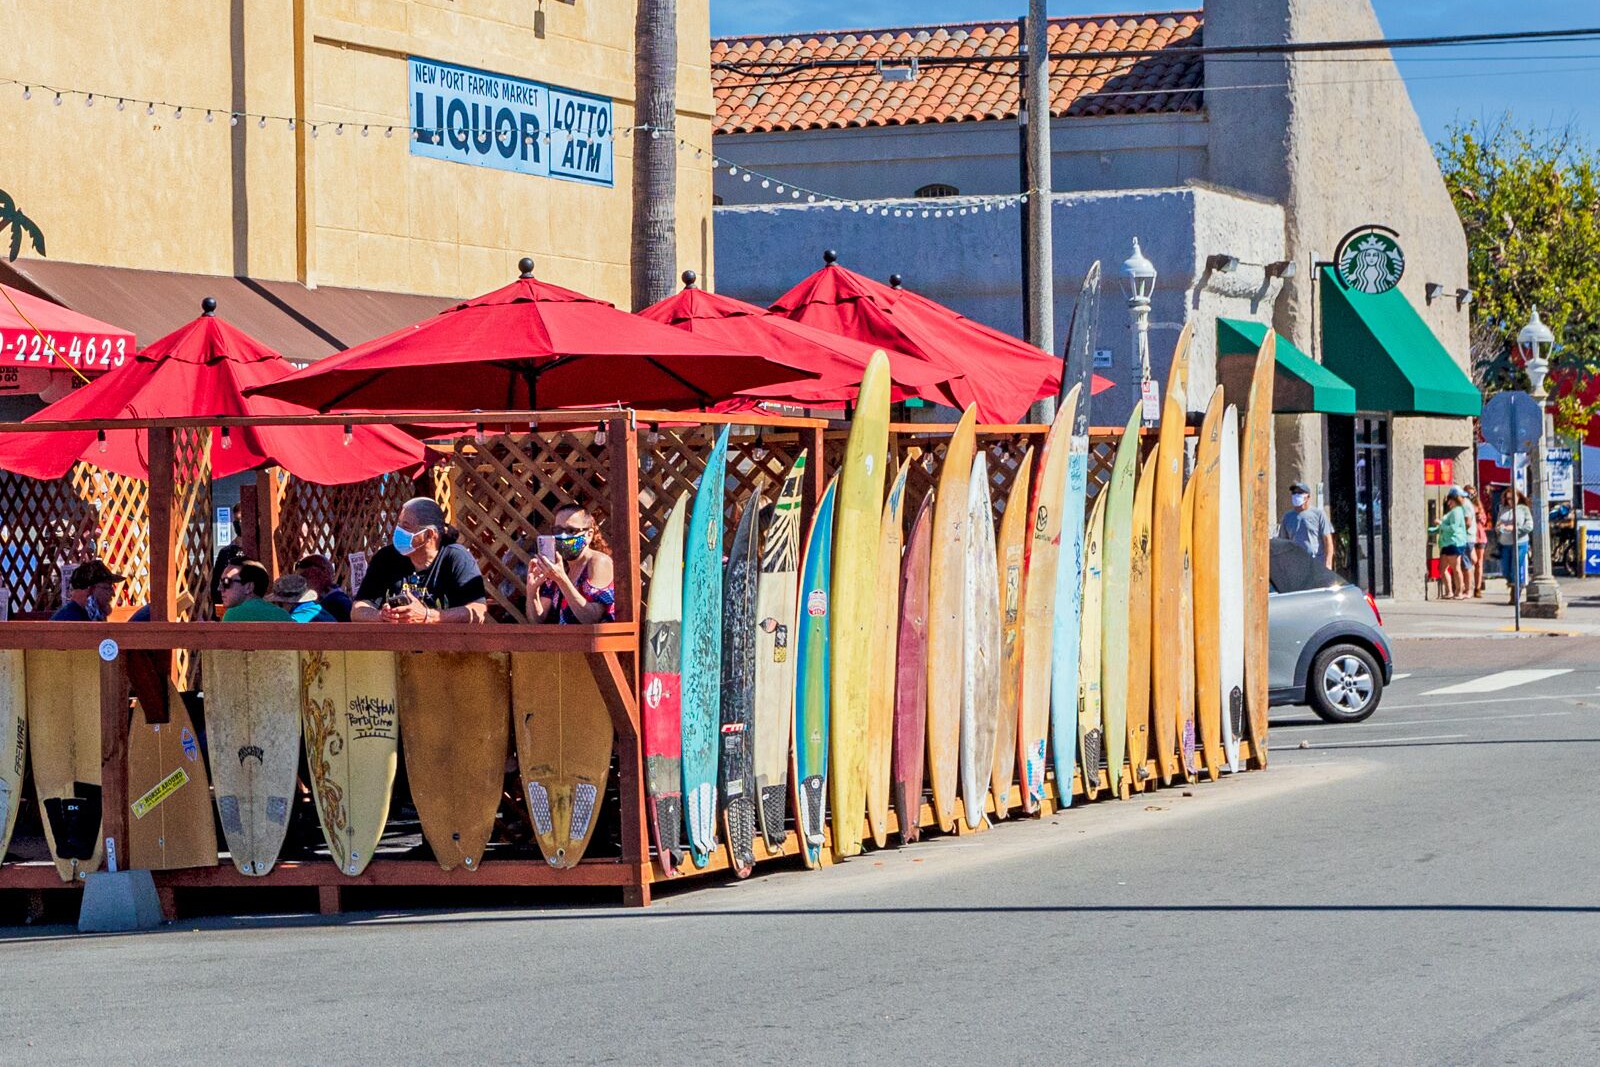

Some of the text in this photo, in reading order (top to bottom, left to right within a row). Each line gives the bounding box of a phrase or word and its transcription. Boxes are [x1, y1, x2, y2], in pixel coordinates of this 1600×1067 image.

[415, 64, 538, 107] NEW PORT FARMS MARKET
[416, 92, 540, 164] LIQUOR
[554, 98, 607, 138] LOTTO
[562, 139, 602, 174] ATM
[4, 374, 17, 382] GO
[14, 716, 25, 776] FIREWIRE
